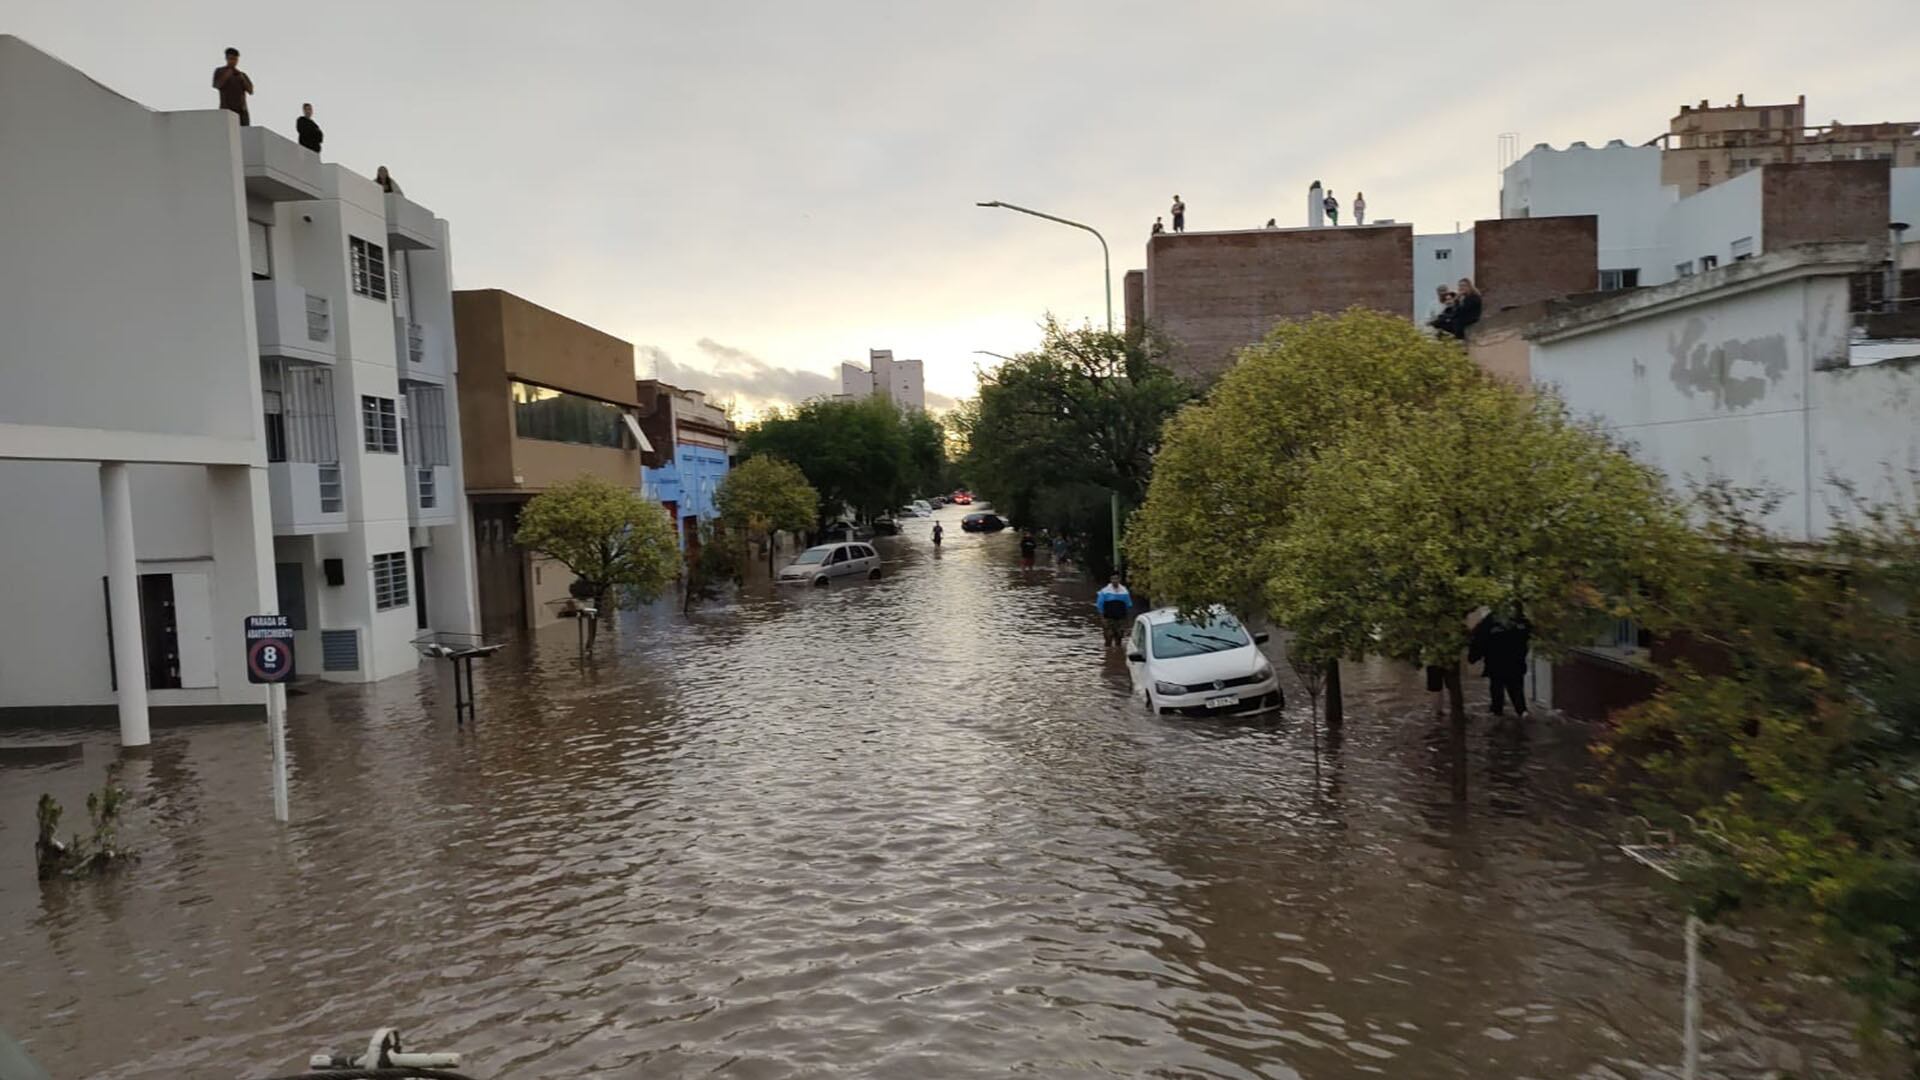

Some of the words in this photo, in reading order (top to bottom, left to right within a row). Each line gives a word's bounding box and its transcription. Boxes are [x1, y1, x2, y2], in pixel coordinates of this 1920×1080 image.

[250, 616, 276, 626] PARADA
[277, 616, 287, 626] DE
[263, 646, 277, 662] 8
